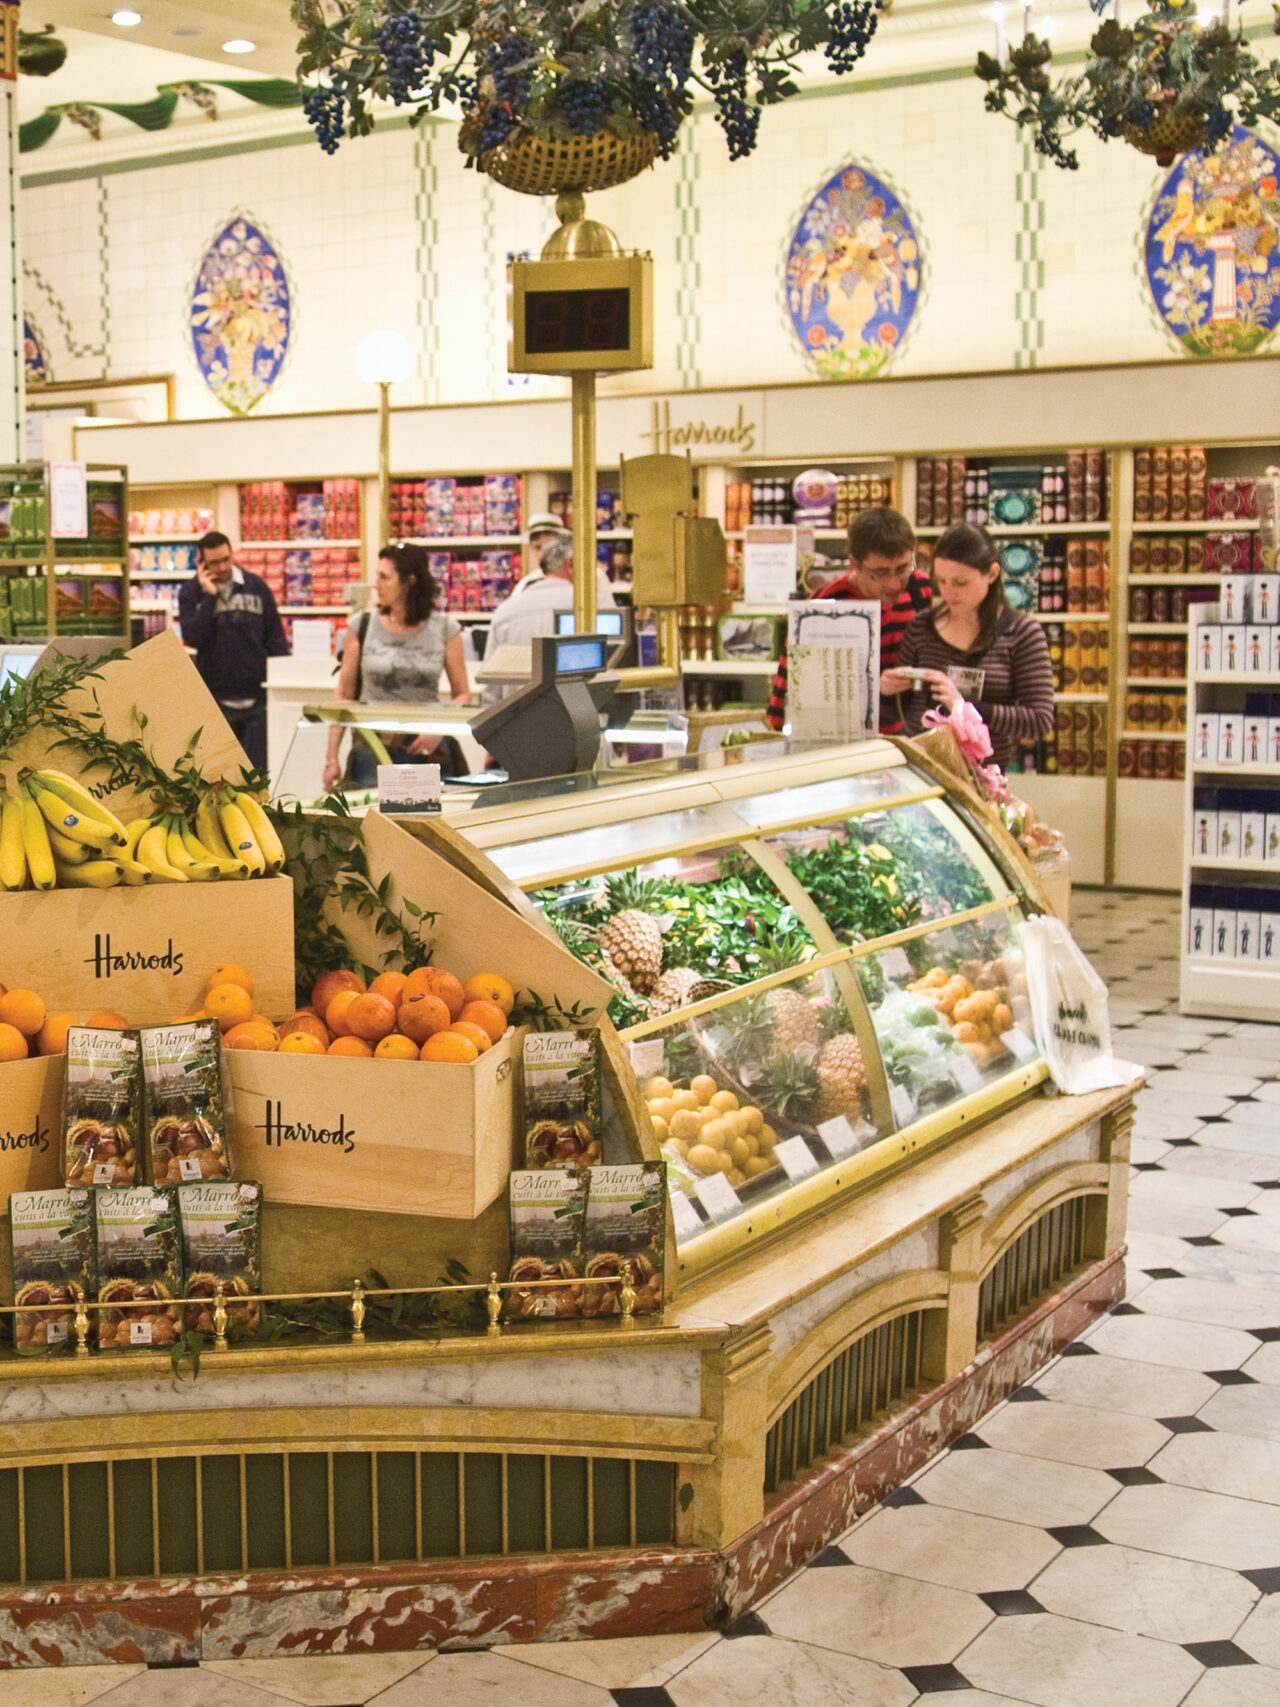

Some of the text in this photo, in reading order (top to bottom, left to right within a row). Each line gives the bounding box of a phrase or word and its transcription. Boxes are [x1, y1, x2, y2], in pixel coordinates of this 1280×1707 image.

[639, 399, 756, 454] Harrods
[88, 765, 141, 799] rrods
[84, 933, 183, 978] Harrods
[254, 1099, 355, 1153] Harrods
[15, 1212, 36, 1222] cuits
[47, 1209, 56, 1219] la
